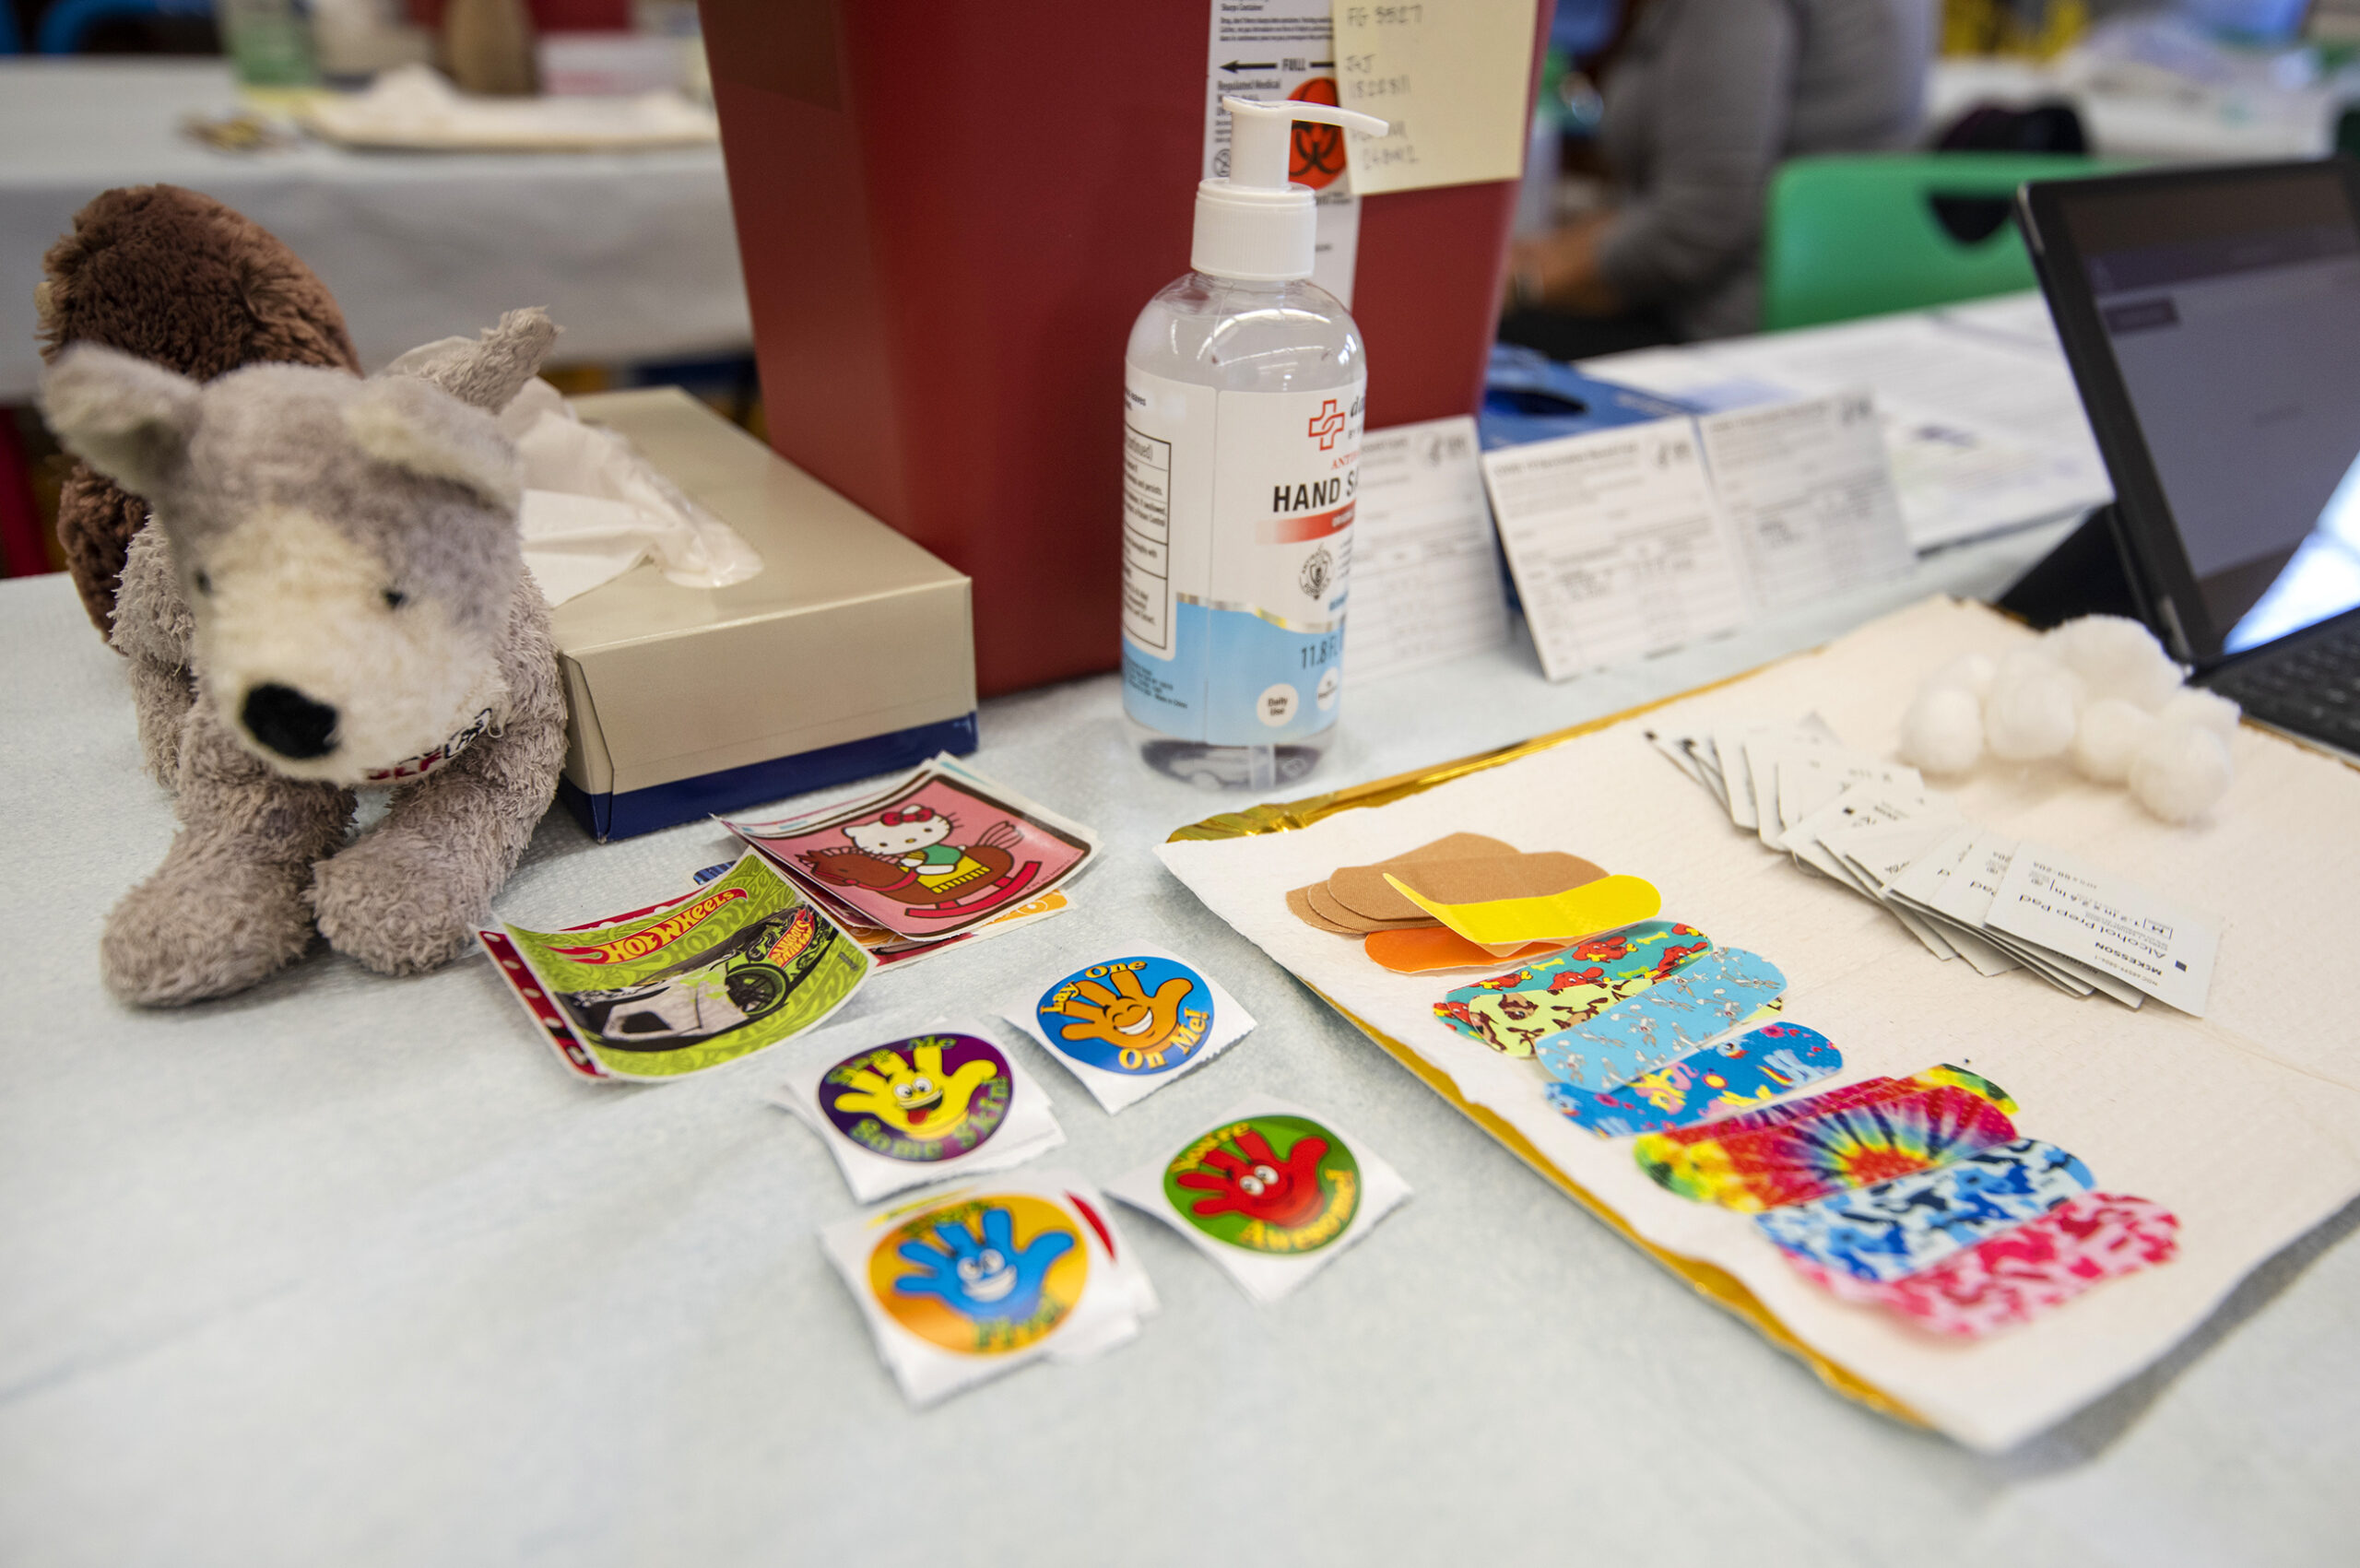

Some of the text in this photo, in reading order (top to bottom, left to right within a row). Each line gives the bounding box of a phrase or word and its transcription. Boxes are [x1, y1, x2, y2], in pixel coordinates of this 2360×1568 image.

[1273, 477, 1341, 513] HAND
[1301, 640, 1328, 670] 11.8
[1267, 696, 1289, 708] Daily
[2018, 893, 2052, 913] Pad
[2056, 908, 2095, 929] Prep
[604, 932, 661, 964] HOT
[2100, 925, 2166, 959] Alcohol
[1039, 960, 1148, 1015] Lay One
[906, 1034, 958, 1051] Me
[1117, 1006, 1210, 1070] On Me!
